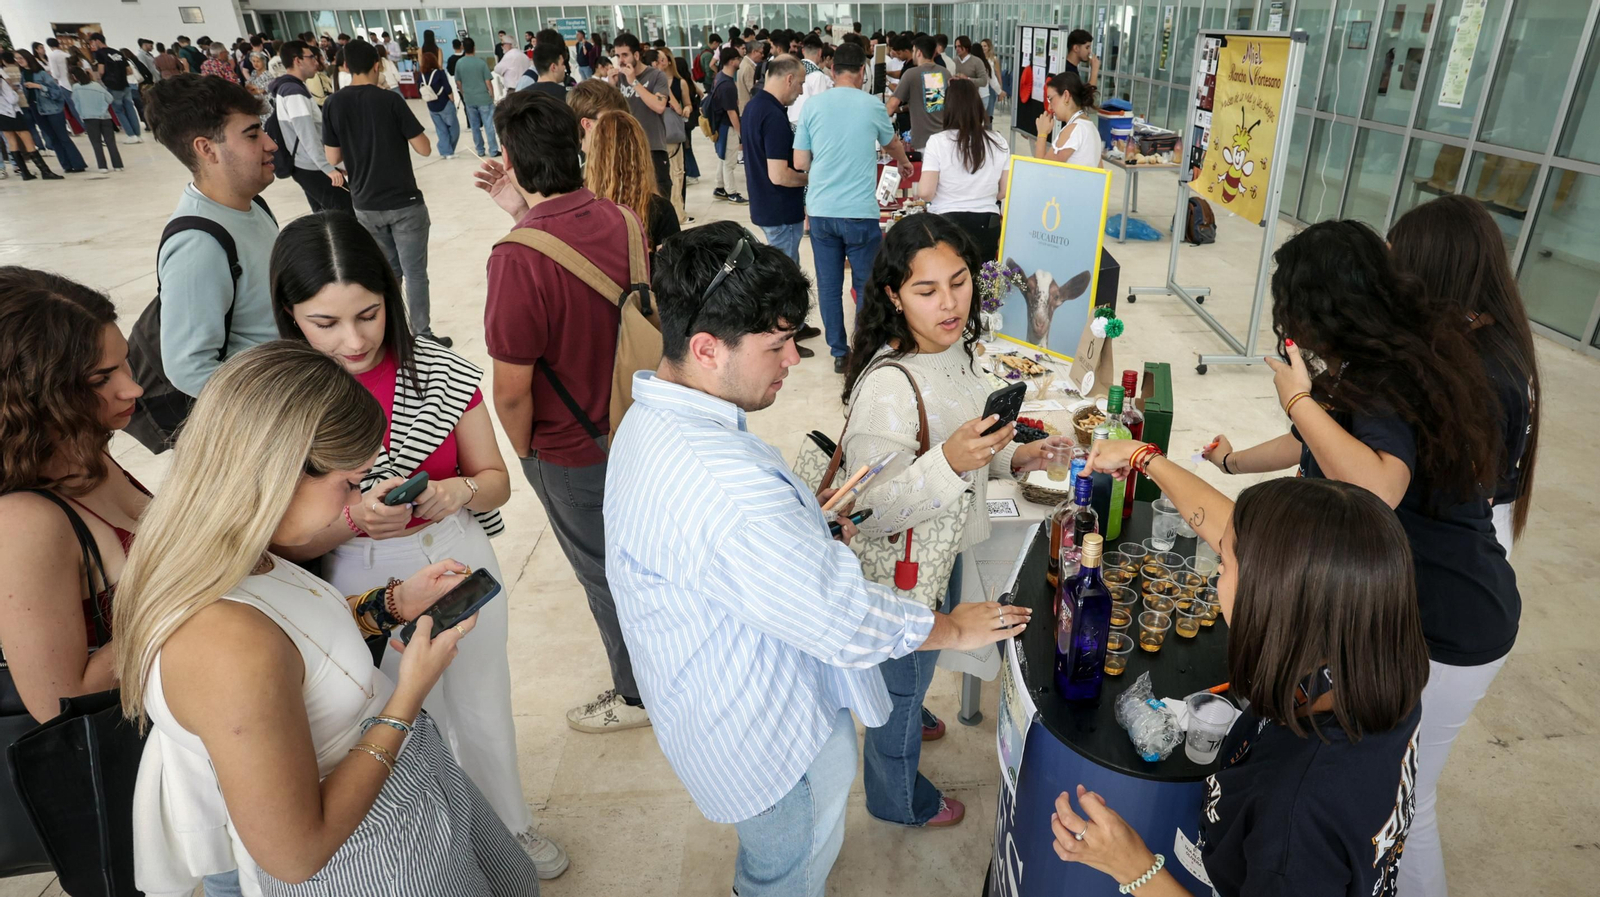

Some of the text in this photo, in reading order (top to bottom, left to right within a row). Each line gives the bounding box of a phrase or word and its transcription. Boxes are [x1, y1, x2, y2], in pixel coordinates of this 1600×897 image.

[1228, 63, 1281, 89] Rancho Cortesano
[1032, 230, 1070, 247] BUCARITO
